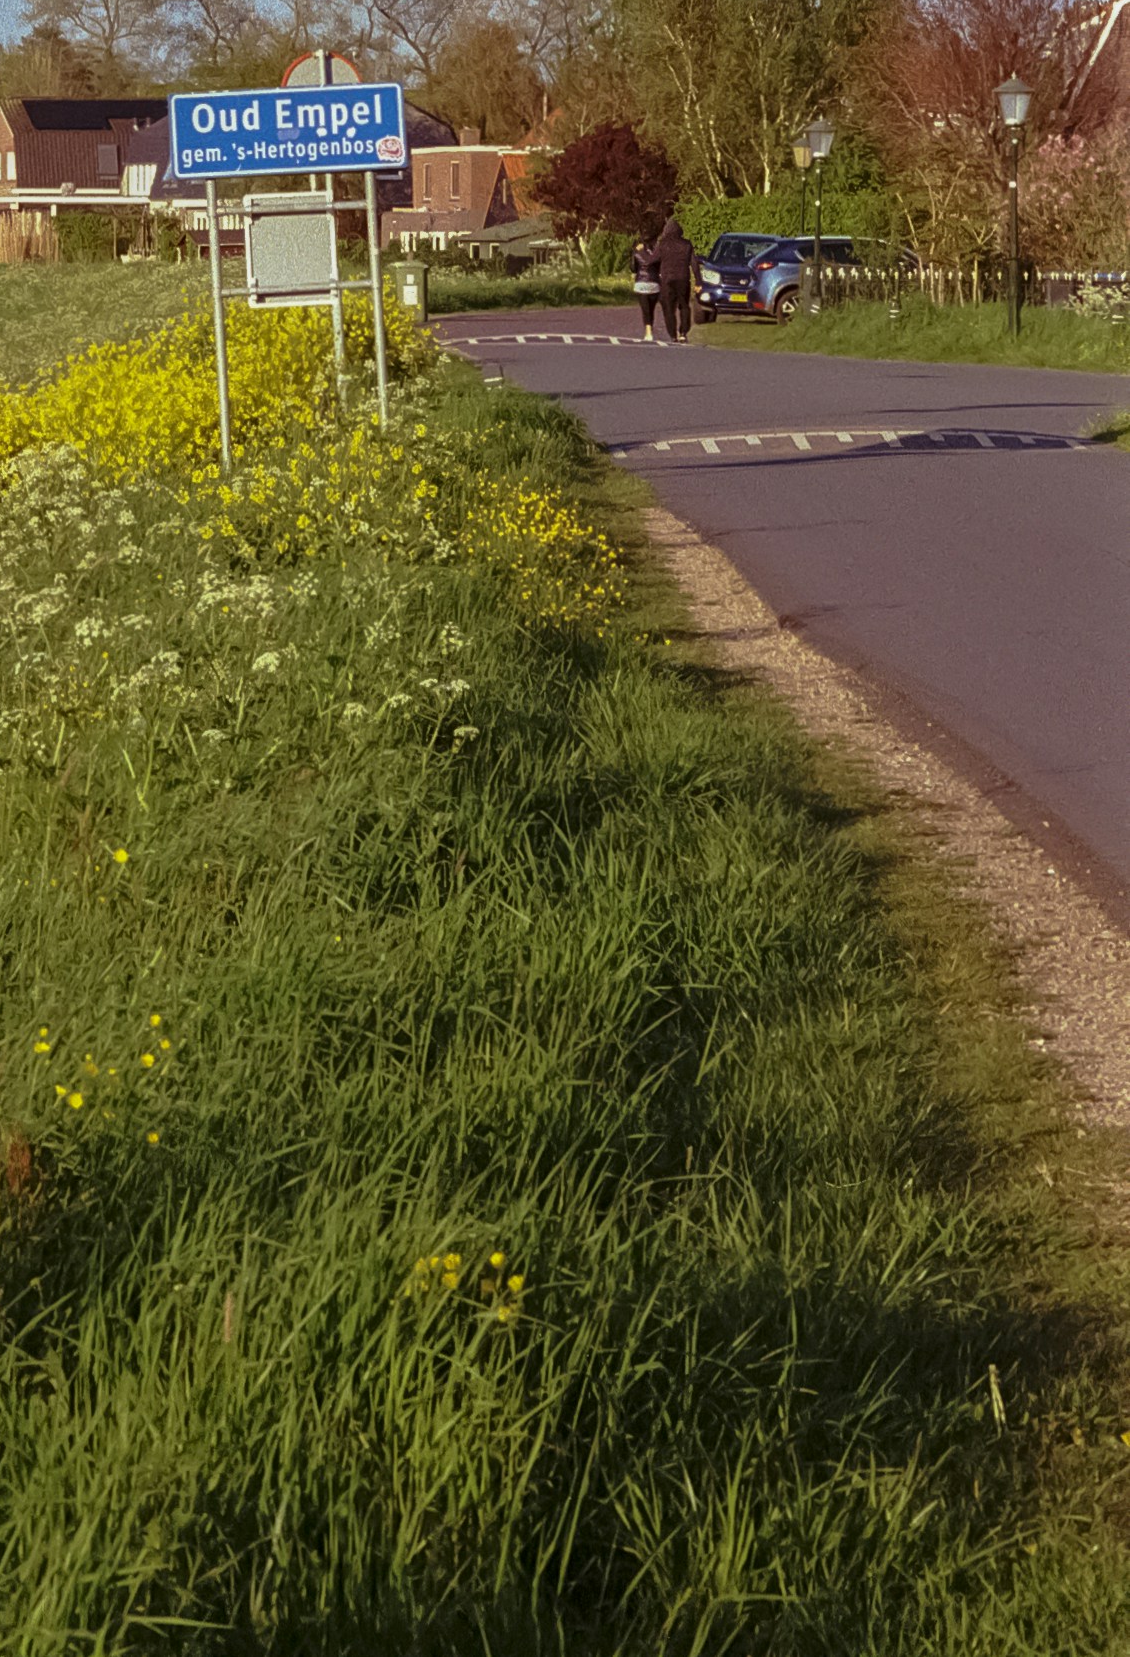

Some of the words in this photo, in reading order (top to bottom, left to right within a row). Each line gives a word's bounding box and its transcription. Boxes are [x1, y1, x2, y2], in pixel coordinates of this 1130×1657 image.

[191, 100, 260, 133] Oud
[276, 94, 382, 134] Empel
[182, 147, 227, 168] gem.
[232, 137, 374, 161] 's-Hertogenbos
